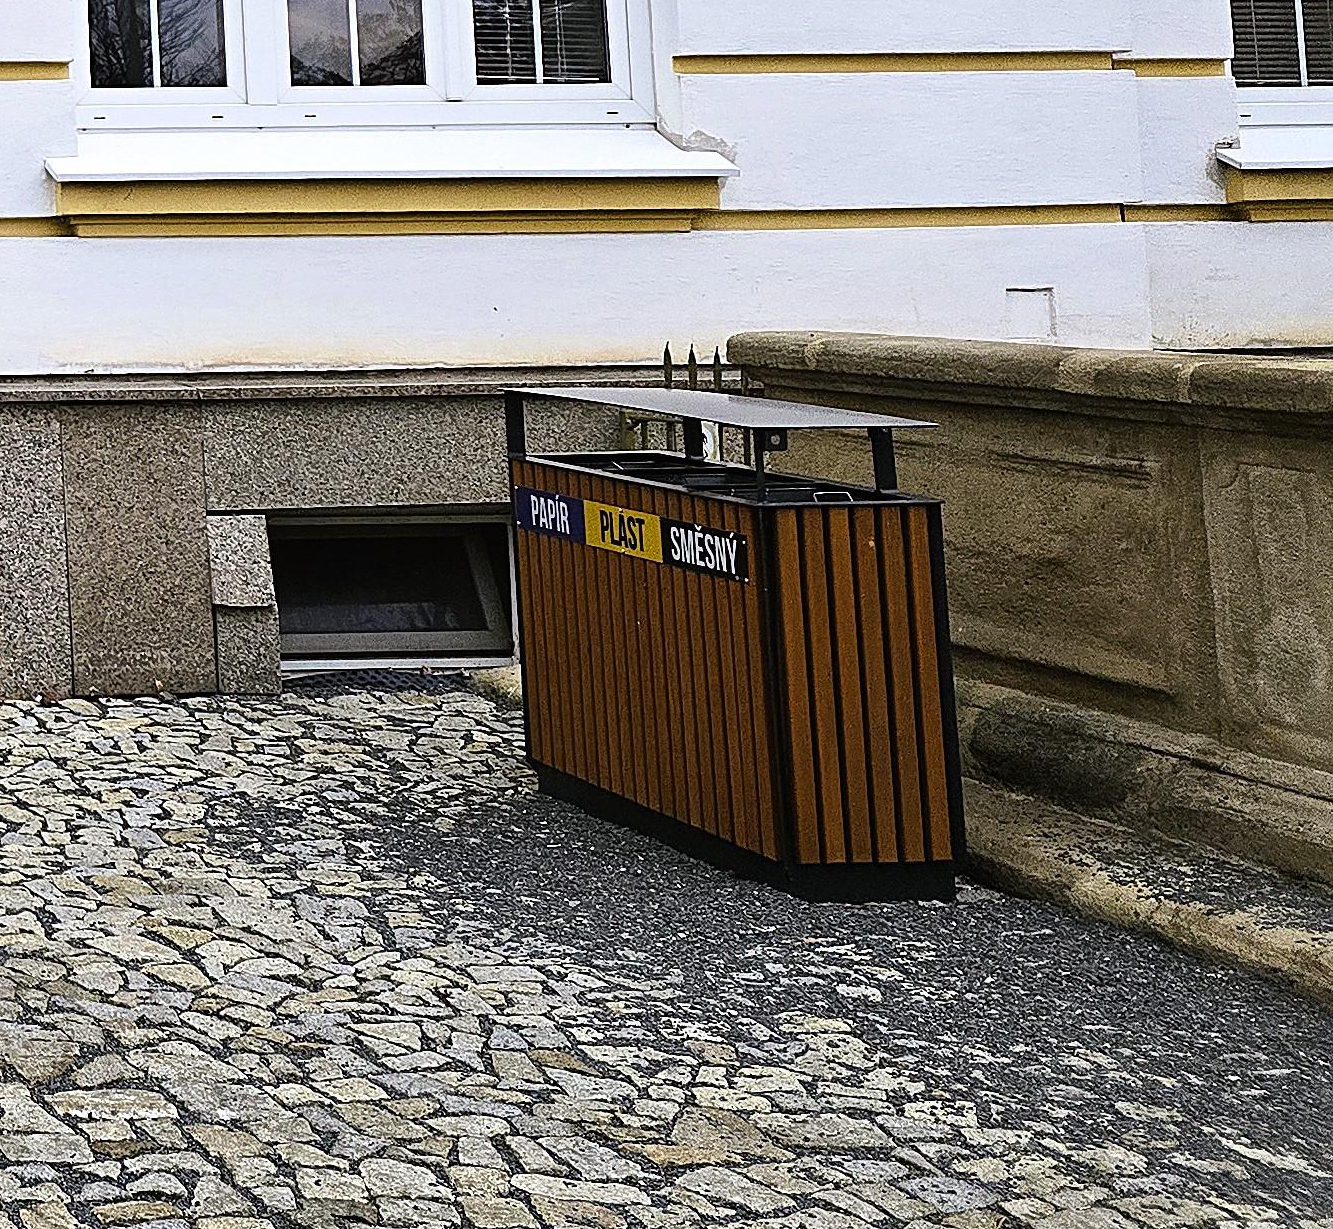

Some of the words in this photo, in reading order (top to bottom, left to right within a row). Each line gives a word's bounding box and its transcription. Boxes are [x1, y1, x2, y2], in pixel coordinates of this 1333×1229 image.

[530, 494, 571, 535] PAPÍR
[599, 510, 646, 553] PLAST
[670, 524, 737, 575] SMĚSNÝ
